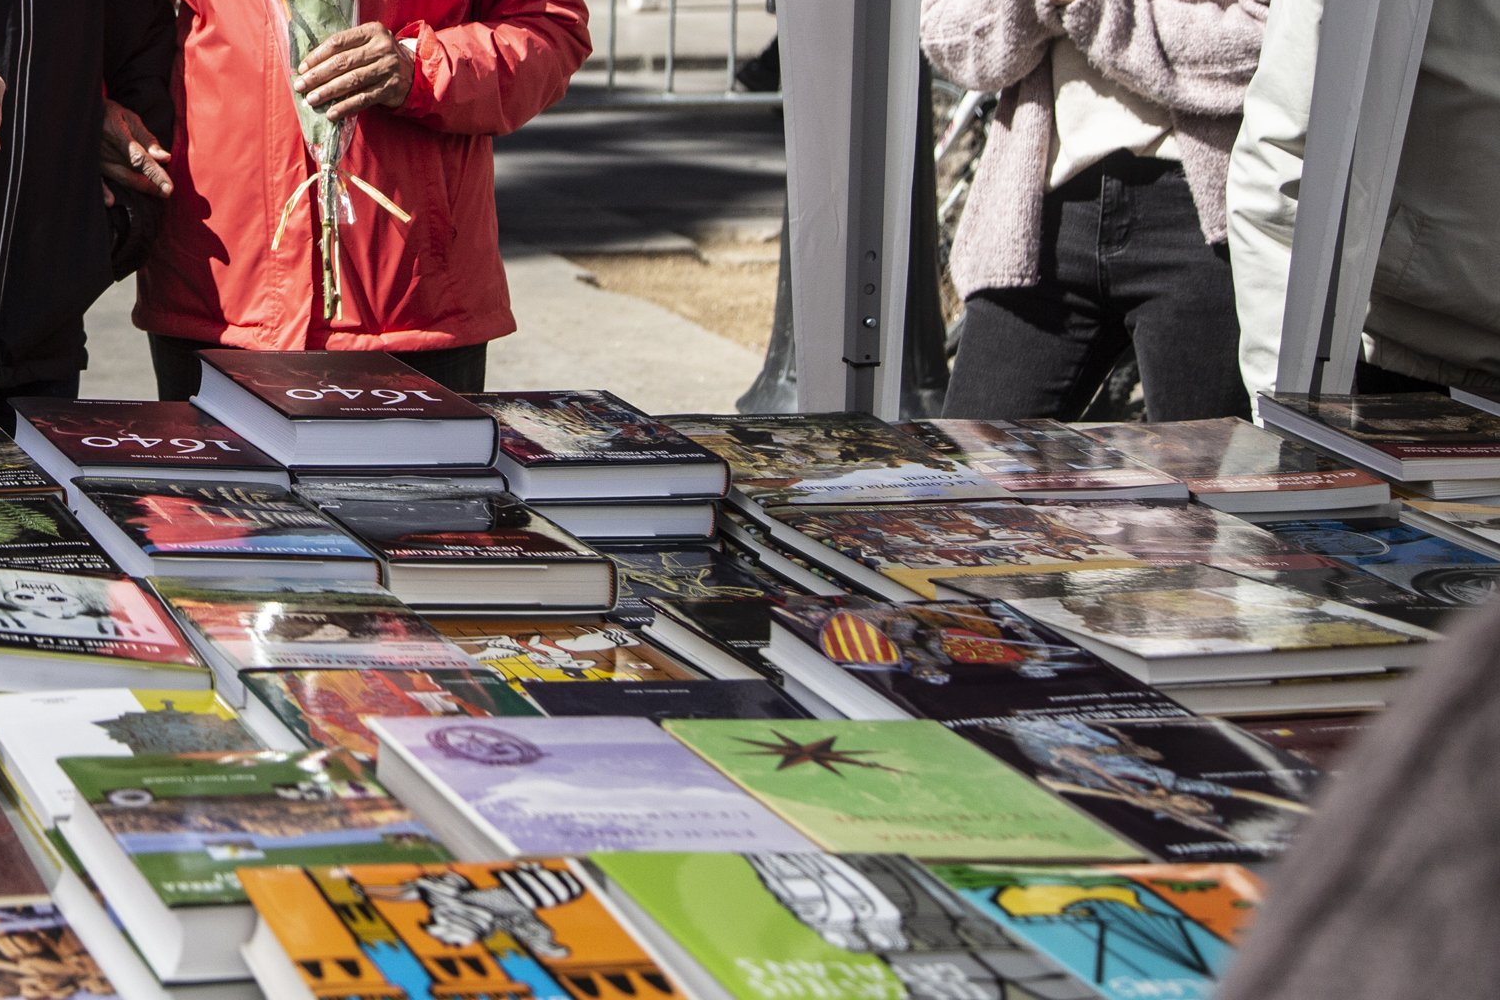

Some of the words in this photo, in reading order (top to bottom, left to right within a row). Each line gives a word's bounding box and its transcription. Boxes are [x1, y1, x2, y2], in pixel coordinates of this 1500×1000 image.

[286, 385, 442, 405] 1640
[82, 434, 241, 454] 1640
[900, 474, 953, 482] Orient
[867, 480, 955, 490] Companyia
[59, 639, 79, 647] DE
[84, 640, 138, 651] LLIBRE
[141, 645, 160, 653] EL
